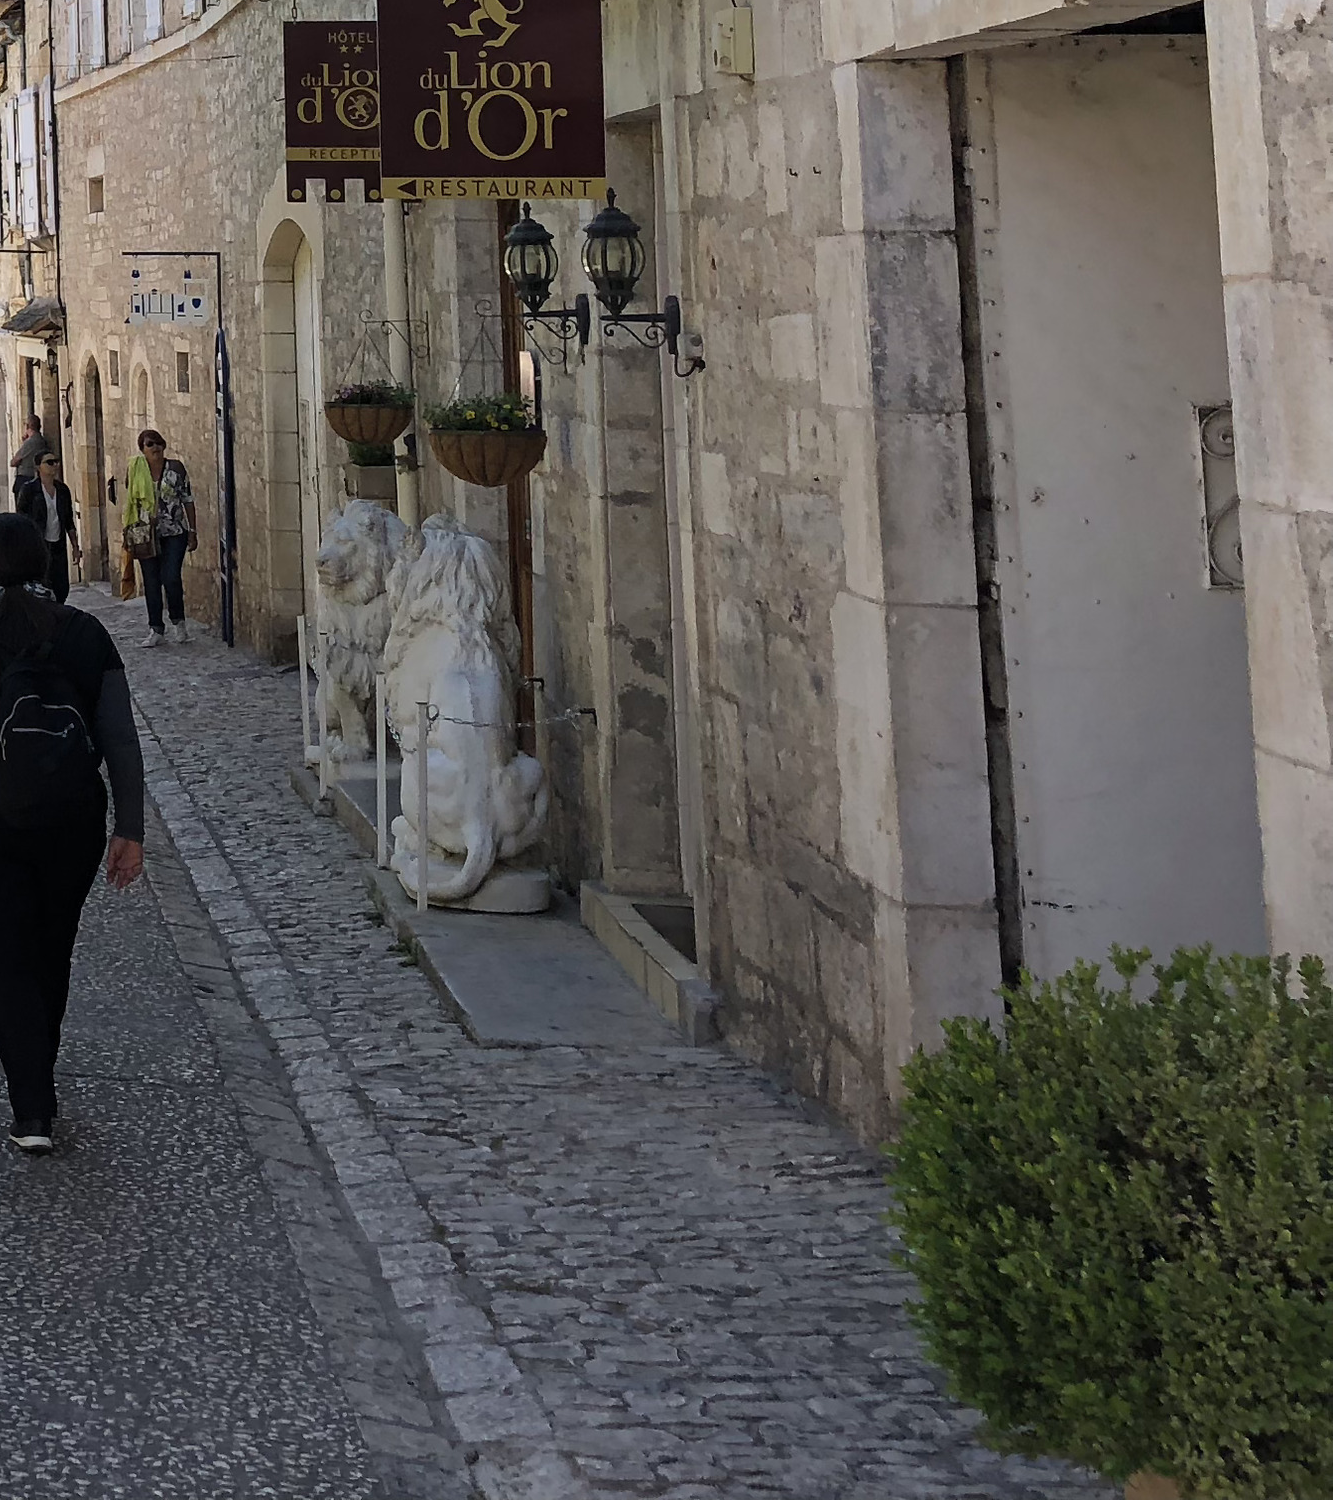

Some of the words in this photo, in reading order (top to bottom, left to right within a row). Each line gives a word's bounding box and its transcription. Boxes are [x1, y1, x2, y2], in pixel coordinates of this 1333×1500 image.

[328, 29, 374, 43] HÔTEL
[420, 68, 448, 90] du
[444, 50, 552, 89] Lion
[300, 73, 322, 87] du
[297, 86, 381, 130] d'O
[414, 89, 568, 161] d'Or
[309, 149, 381, 160] RECEPTI
[423, 180, 593, 197] RESTAURANT
